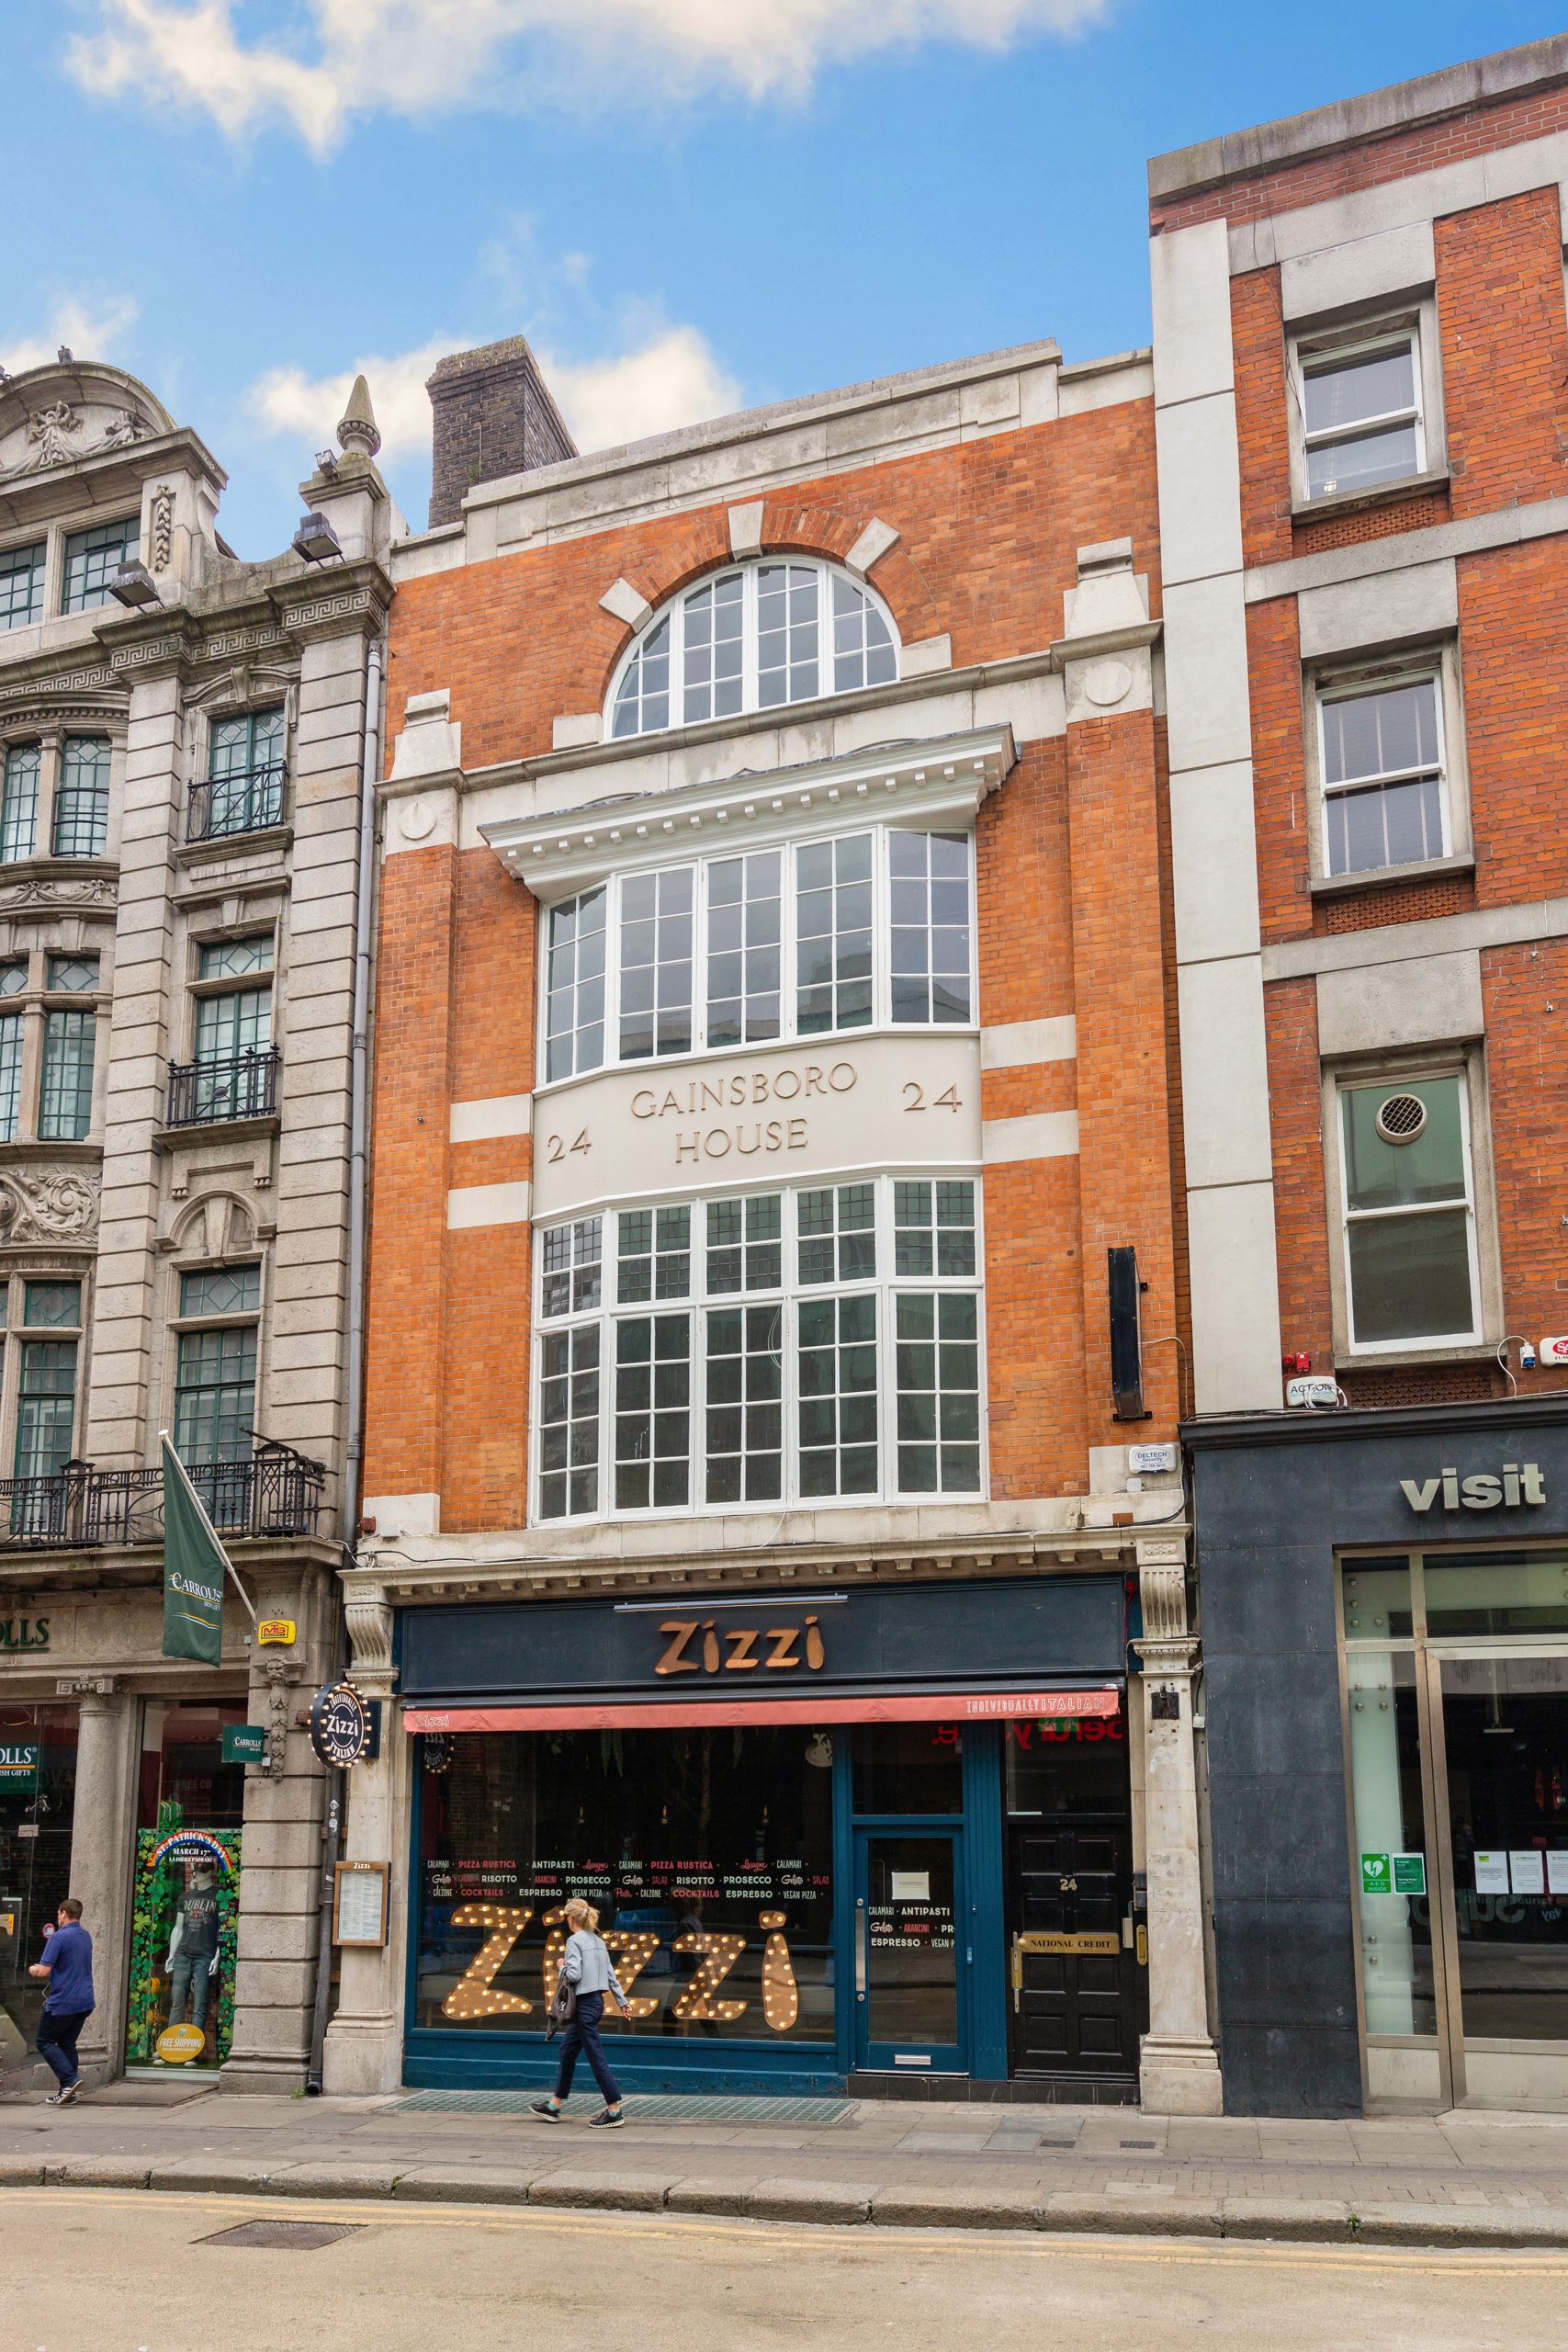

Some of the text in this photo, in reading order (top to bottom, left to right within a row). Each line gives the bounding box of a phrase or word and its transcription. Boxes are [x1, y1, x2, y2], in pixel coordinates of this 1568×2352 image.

[630, 1062, 859, 1119] GAINSBORO
[902, 1081, 963, 1113] 24
[547, 1125, 592, 1164] 24
[675, 1118, 809, 1163] HOUSE
[1399, 1463, 1546, 1511] visit
[0, 1618, 50, 1645] LLS
[653, 1615, 825, 1675] Zizzi
[966, 1697, 1105, 1713] INDIVIDUALLY ITALIAN
[326, 1713, 359, 1737] Zizzi
[415, 1713, 450, 1727] Zizzi
[331, 1740, 356, 1759] ITALIAN
[168, 1832, 212, 1847] PATRICK'S
[210, 1840, 226, 1860] DAY
[427, 1860, 450, 1869] CALAMARI
[532, 1860, 575, 1869] ANTIPASTI
[582, 1859, 609, 1871] Lasagne
[619, 1860, 643, 1869] CALAMARI
[740, 1859, 768, 1871] Lasagne
[776, 1860, 802, 1869] CALAMARI
[432, 1874, 452, 1884] Gelato
[565, 1876, 611, 1884] PROSECCO
[622, 1875, 643, 1885] Gelato
[651, 1876, 668, 1884] SALAD
[676, 1876, 715, 1884] RISOTTO
[723, 1876, 772, 1884] PROSECCO
[781, 1874, 803, 1885] Gelato
[812, 1876, 829, 1884] SALAD
[1059, 1878, 1077, 1891] 24
[433, 1889, 453, 1897] CALZONE
[571, 1889, 587, 1897] VEGAN
[588, 1889, 603, 1897] PIZZA
[640, 1889, 661, 1898] CALZONE
[672, 1890, 719, 1898] COCKTAILS
[726, 1890, 773, 1898] ESPRESSO
[783, 1890, 800, 1899] VEGAN
[801, 1890, 817, 1899] PIZZA
[868, 1906, 950, 1916] CALAMARI ANTIPASTI
[870, 1922, 955, 1933] Gelato ARANCINI PR
[871, 1938, 920, 1947] ESPRESSO
[931, 1939, 949, 1947] VEGAN
[160, 2038, 201, 2047] FREE SHIPPING
